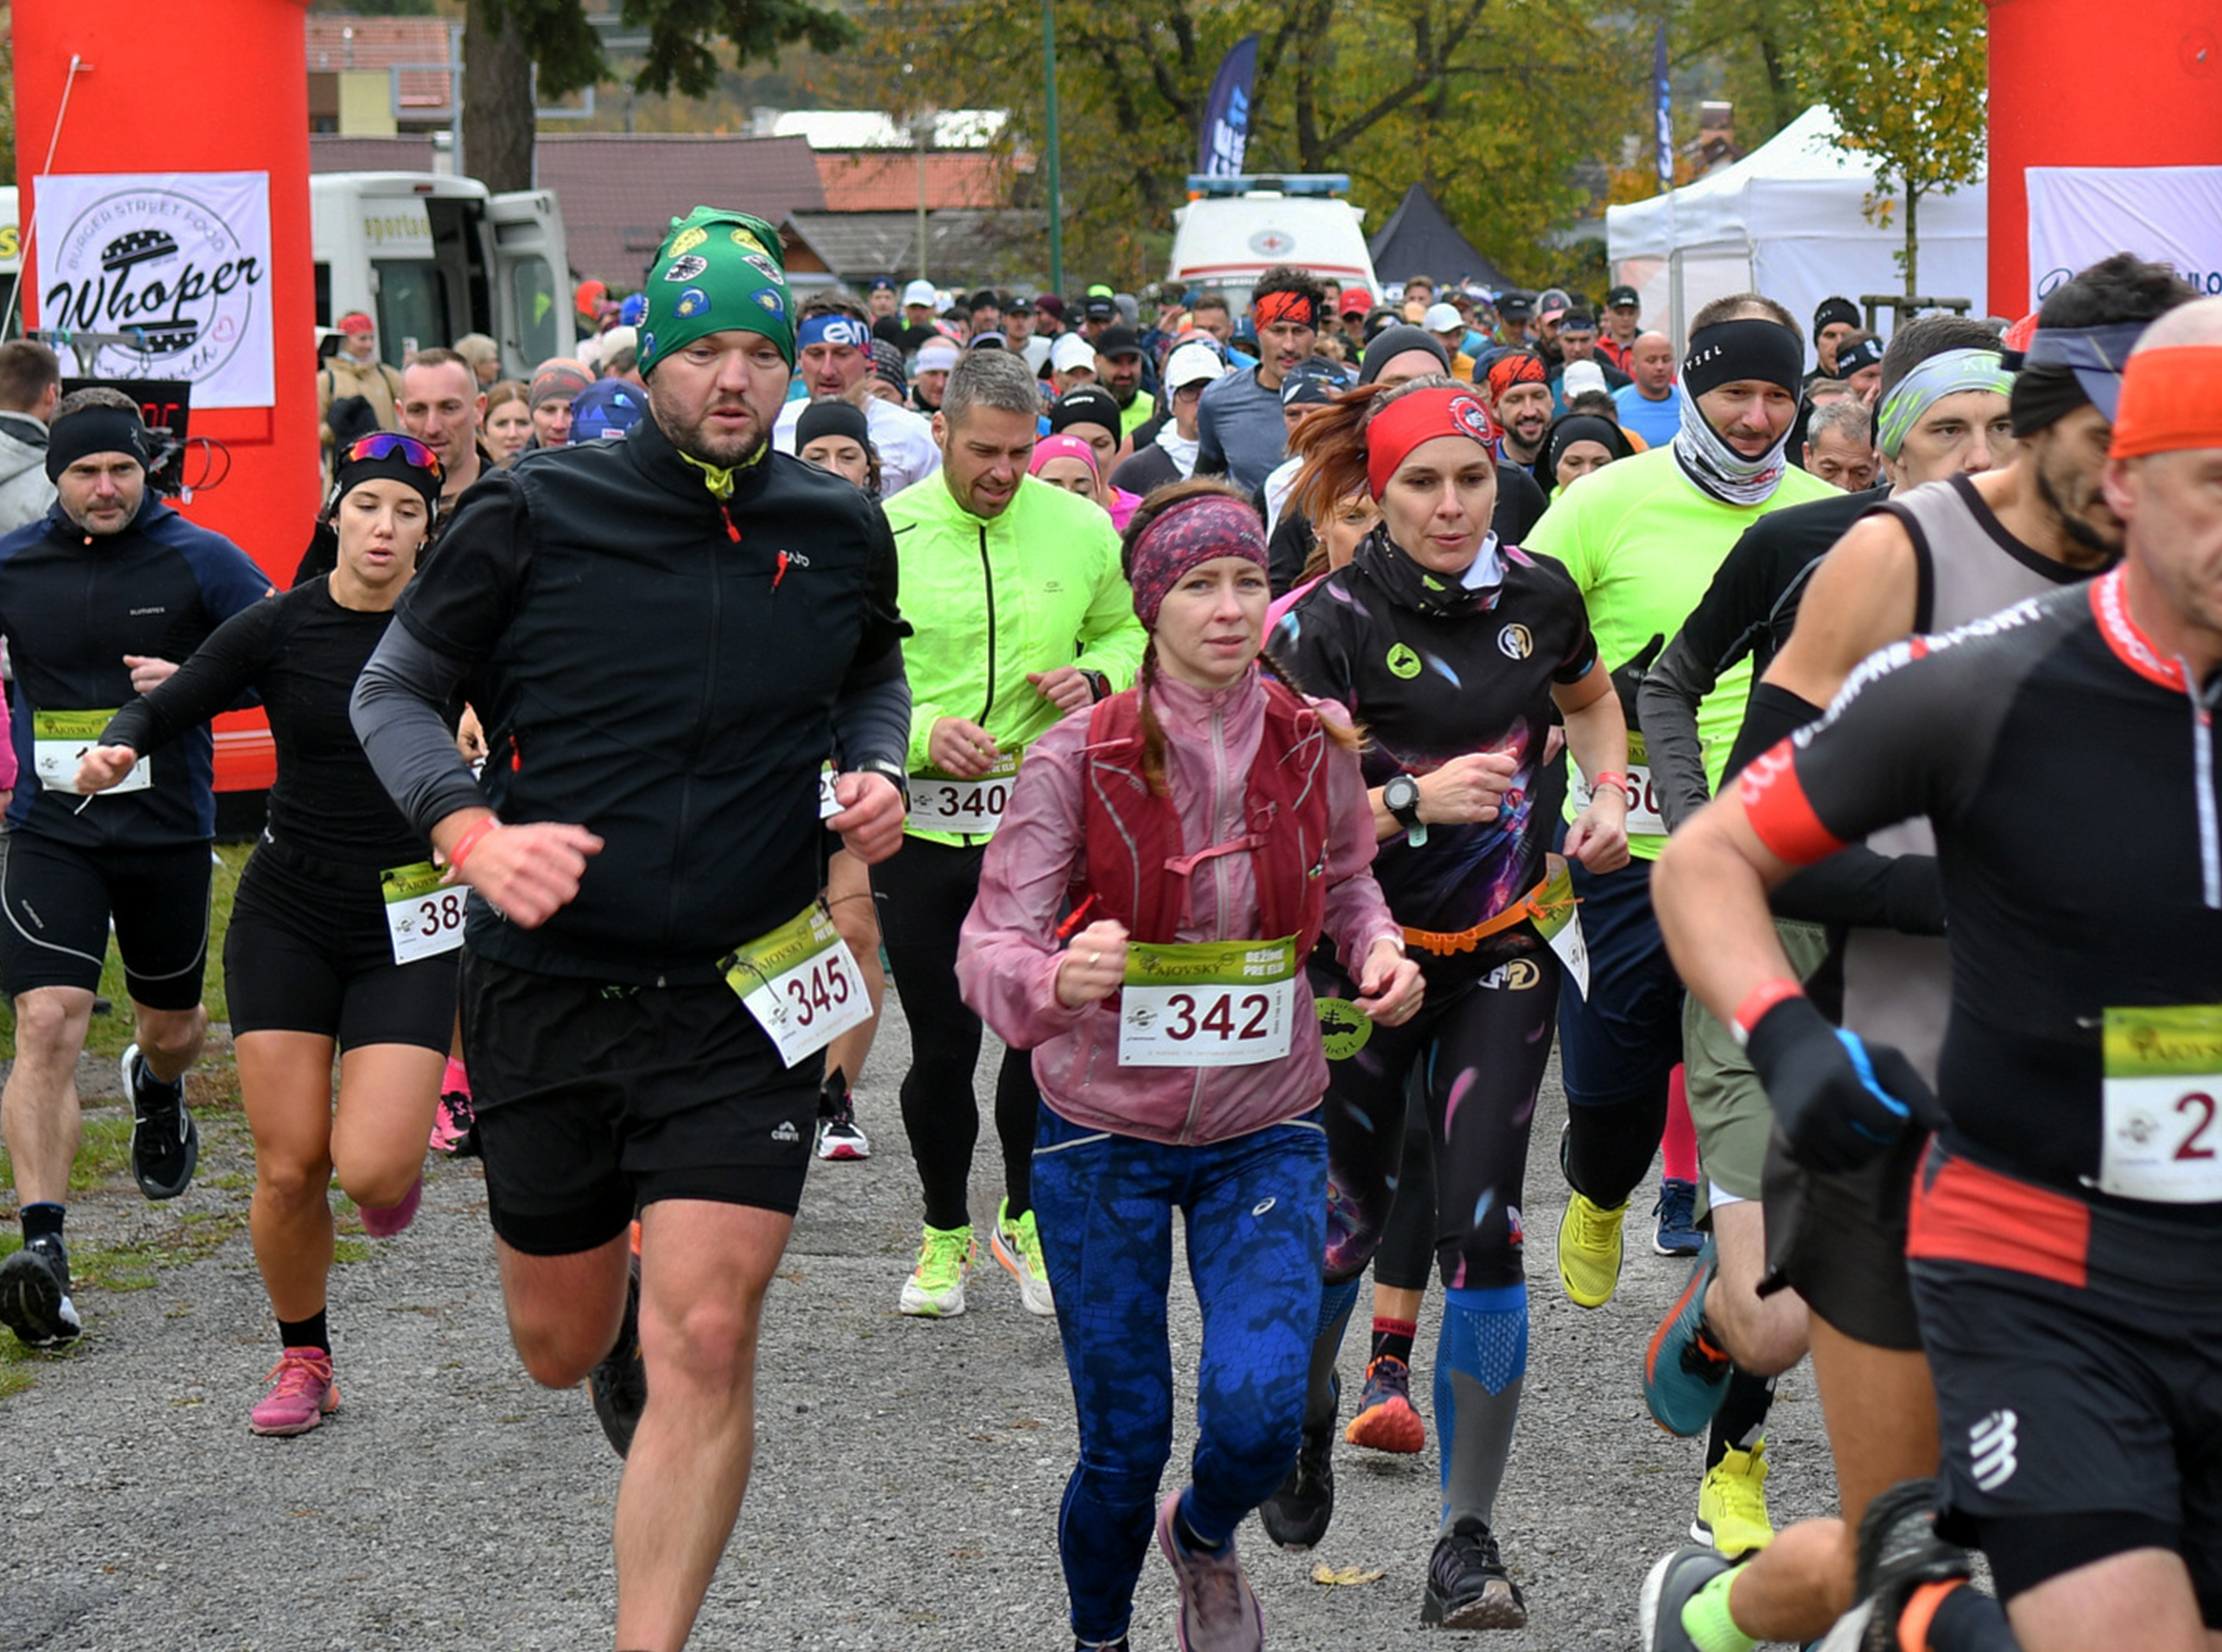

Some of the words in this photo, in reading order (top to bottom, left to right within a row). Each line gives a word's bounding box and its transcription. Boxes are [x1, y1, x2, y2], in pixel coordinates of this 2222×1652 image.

[69, 213, 111, 270] BURGER
[115, 200, 180, 216] STREET
[183, 210, 225, 253] FOOD
[46, 256, 263, 331] Whoper
[938, 784, 1007, 817] 340
[787, 955, 848, 1027] 345
[1165, 994, 1271, 1041] 342
